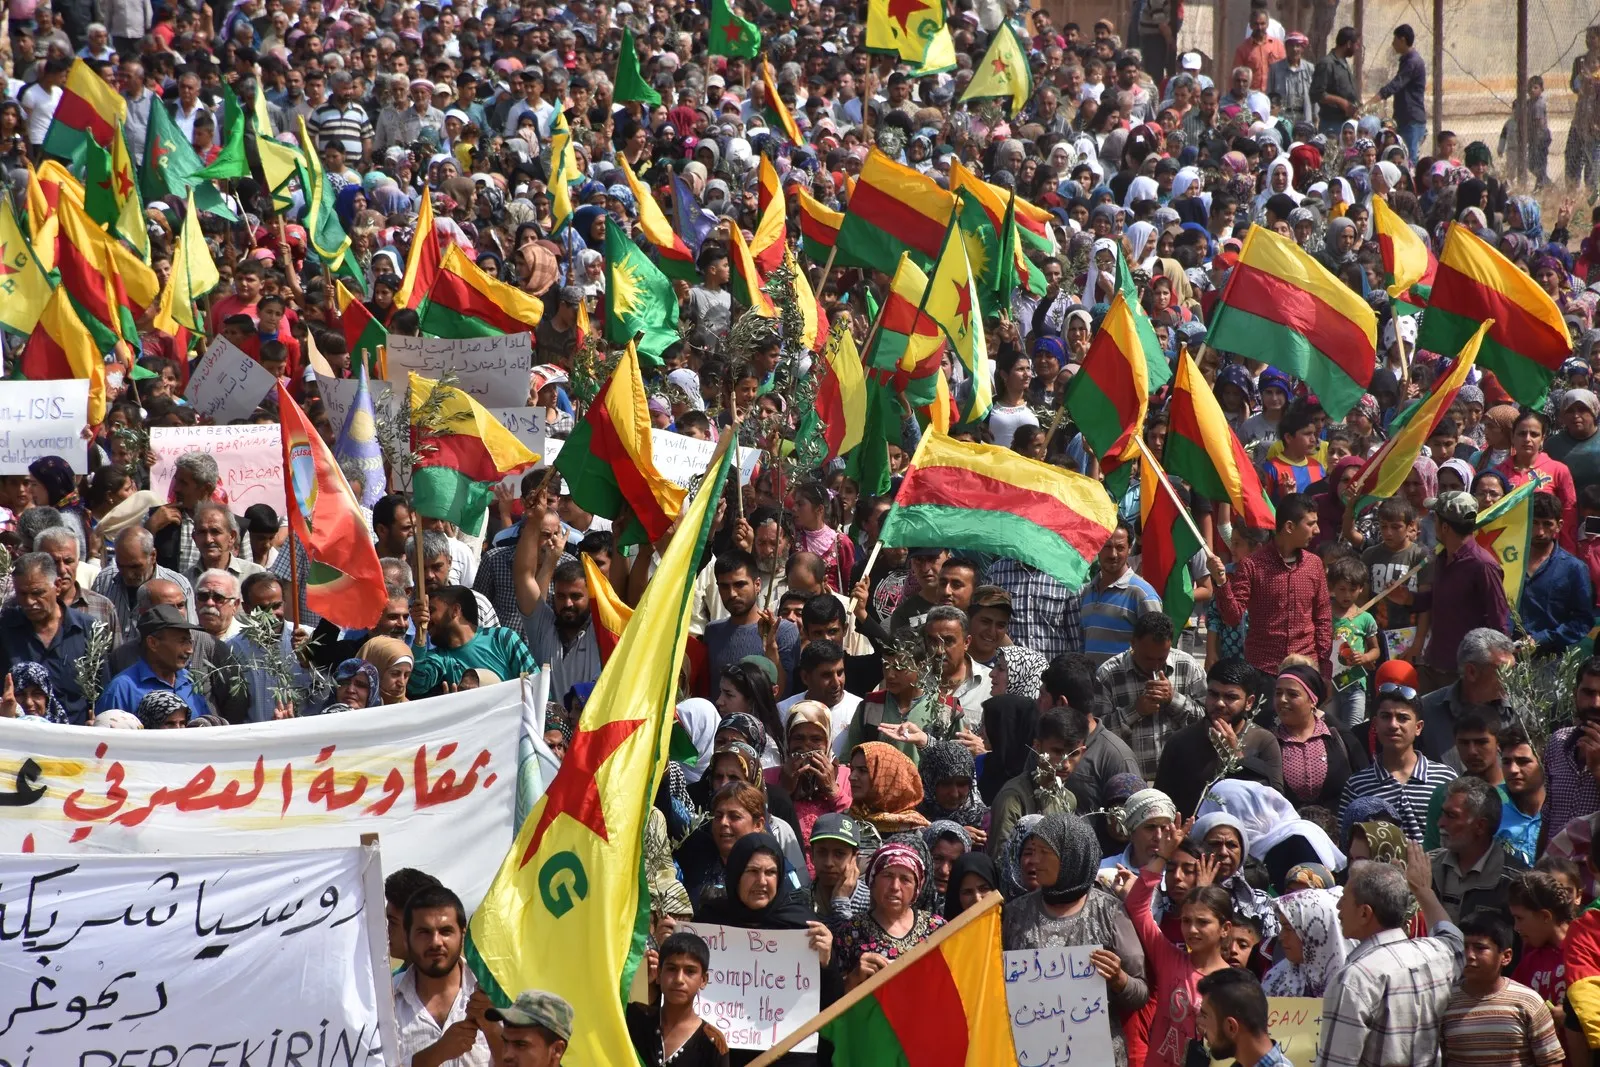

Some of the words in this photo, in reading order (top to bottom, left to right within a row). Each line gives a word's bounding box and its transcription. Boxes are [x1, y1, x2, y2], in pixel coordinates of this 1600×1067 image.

[1503, 545, 1518, 563] G
[538, 850, 588, 919] G
[747, 929, 778, 953] Be
[795, 962, 810, 991] to
[759, 996, 785, 1022] the
